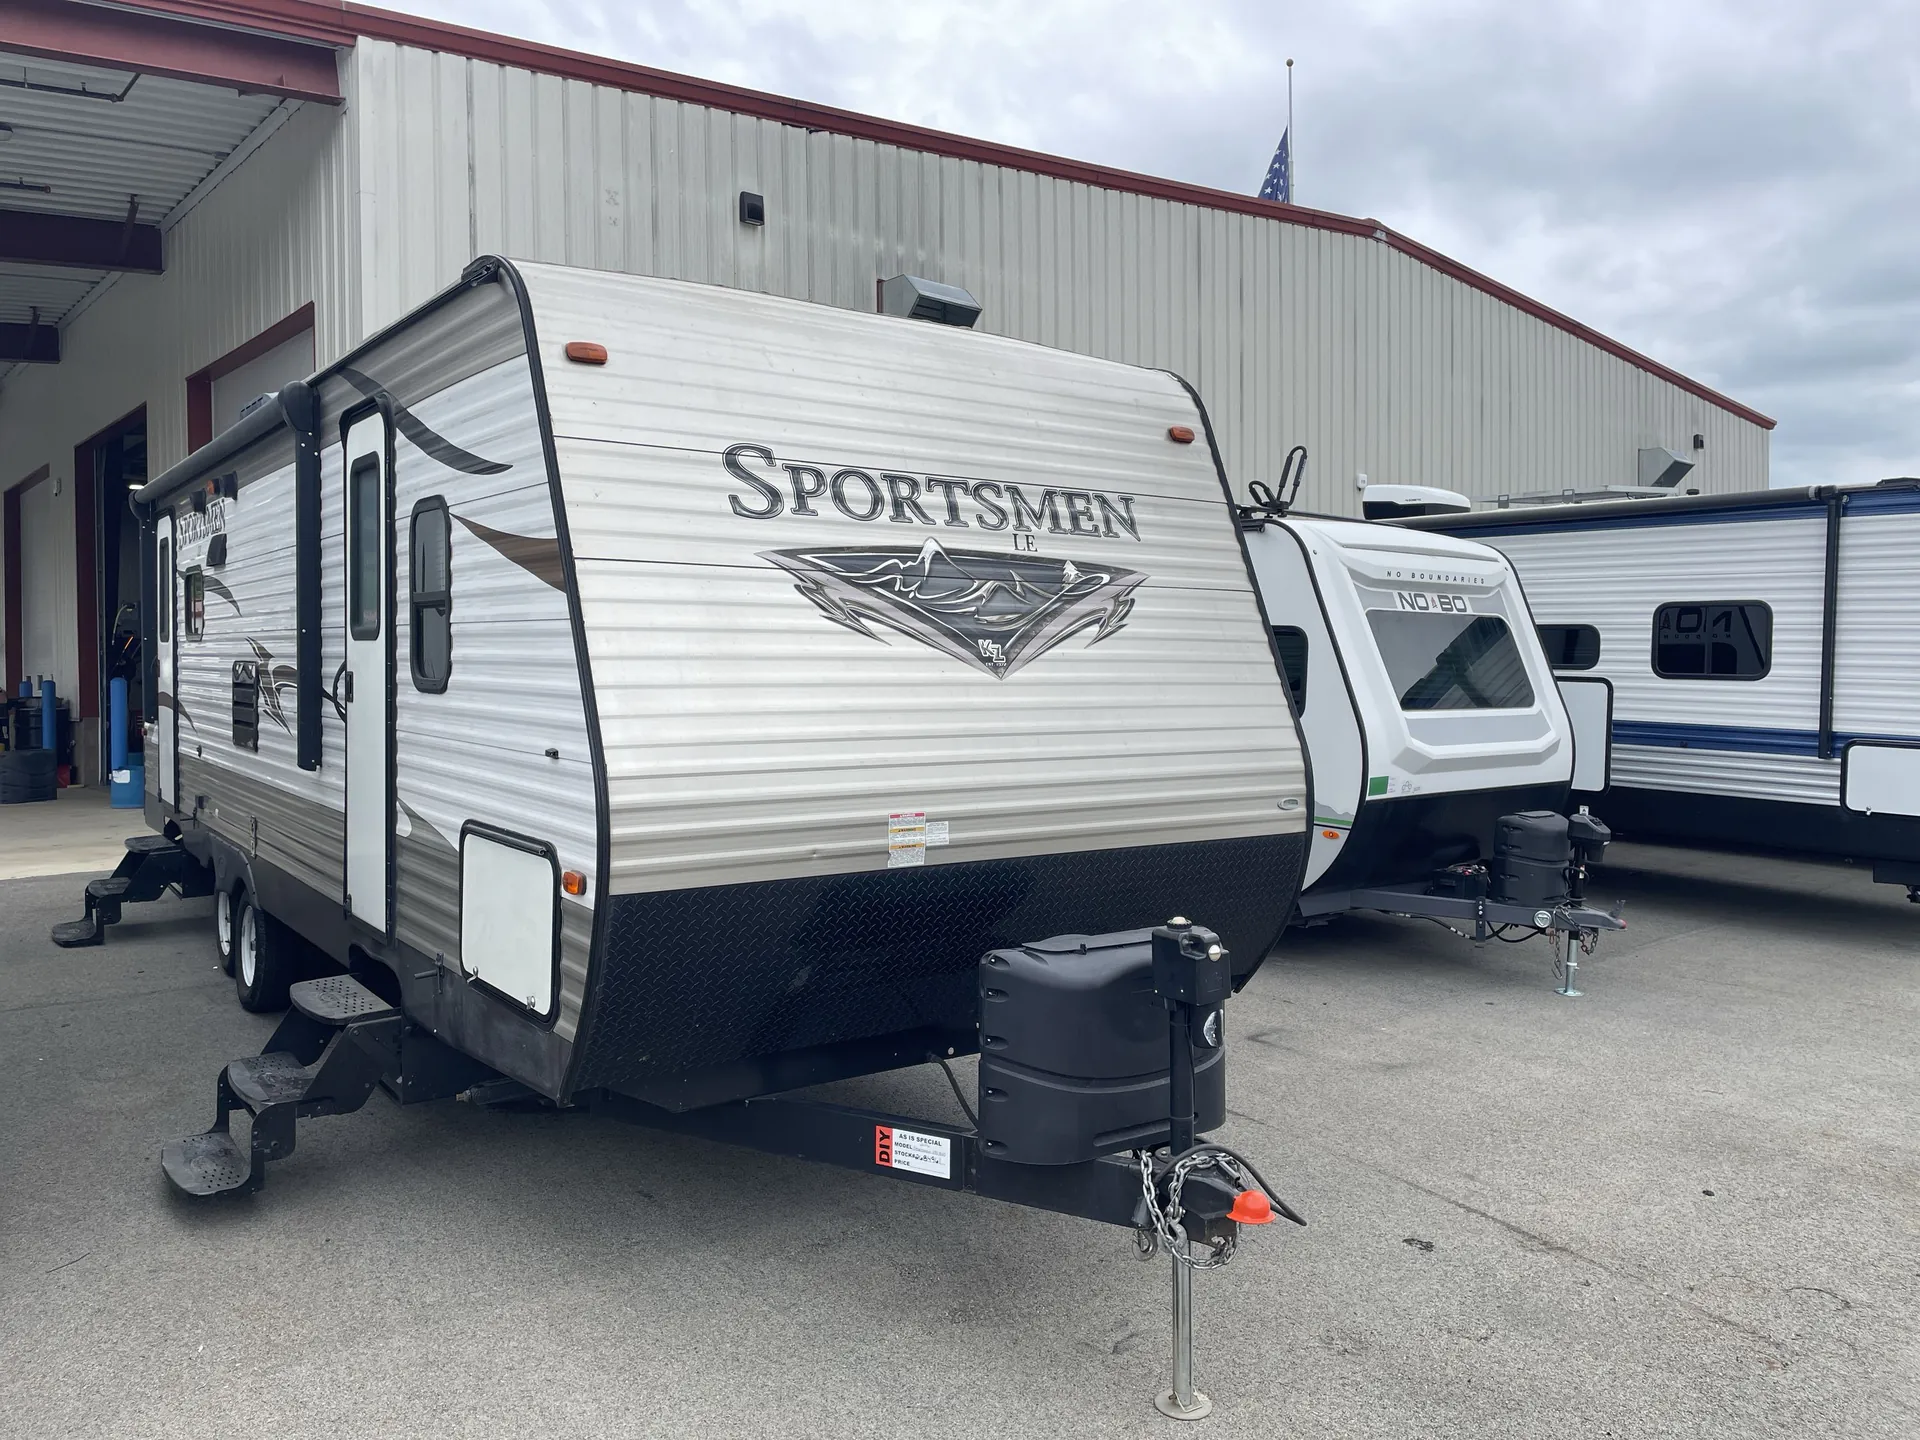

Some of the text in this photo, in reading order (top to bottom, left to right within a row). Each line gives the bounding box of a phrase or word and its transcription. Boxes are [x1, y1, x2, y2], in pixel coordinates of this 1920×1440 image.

[1012, 533, 1039, 553] LE
[1386, 570, 1484, 584] NO BOUNDARIES
[1397, 591, 1467, 612] NO BO
[878, 1129, 891, 1164] DIY
[916, 1136, 942, 1147] SPECIAL
